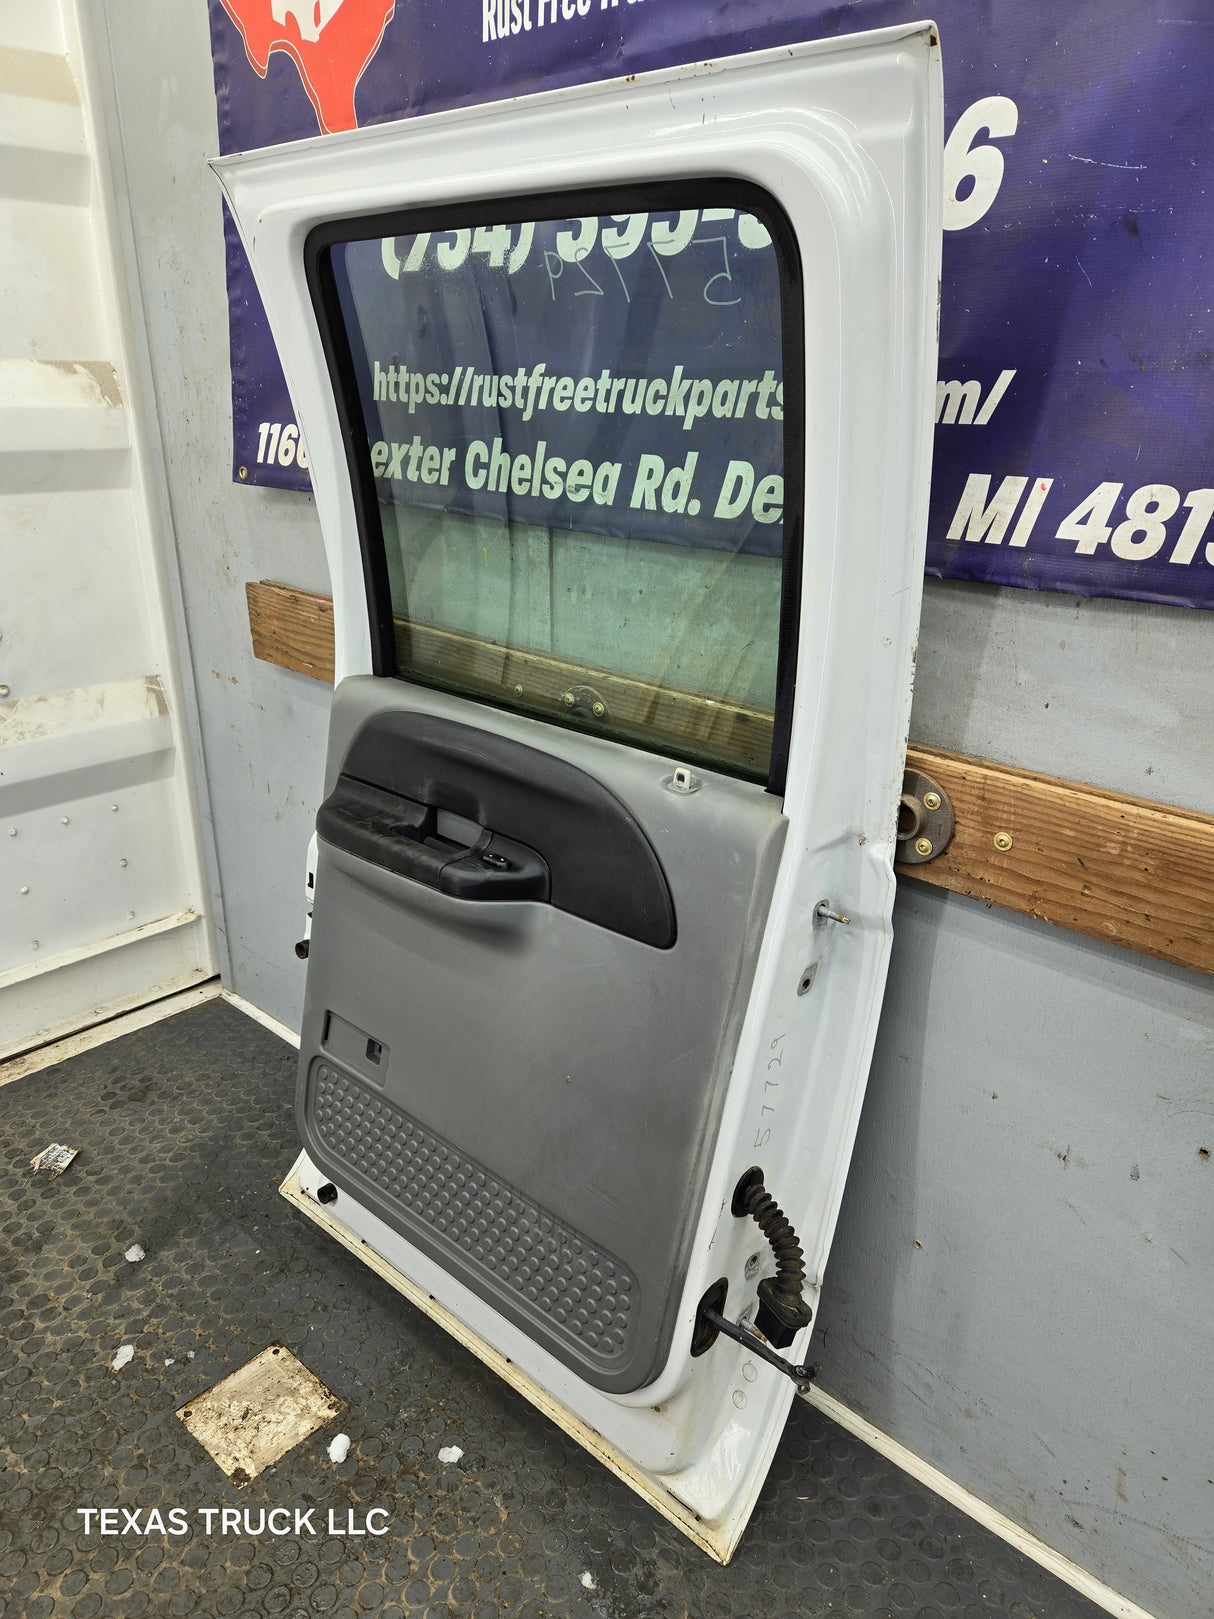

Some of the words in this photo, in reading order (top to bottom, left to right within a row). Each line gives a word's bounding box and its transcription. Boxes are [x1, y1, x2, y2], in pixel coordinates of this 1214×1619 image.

[370, 435, 457, 486] exter
[464, 437, 622, 506] Chelsea
[630, 451, 701, 517] Rd.
[945, 473, 1055, 548] MI
[1054, 481, 1214, 567] 481
